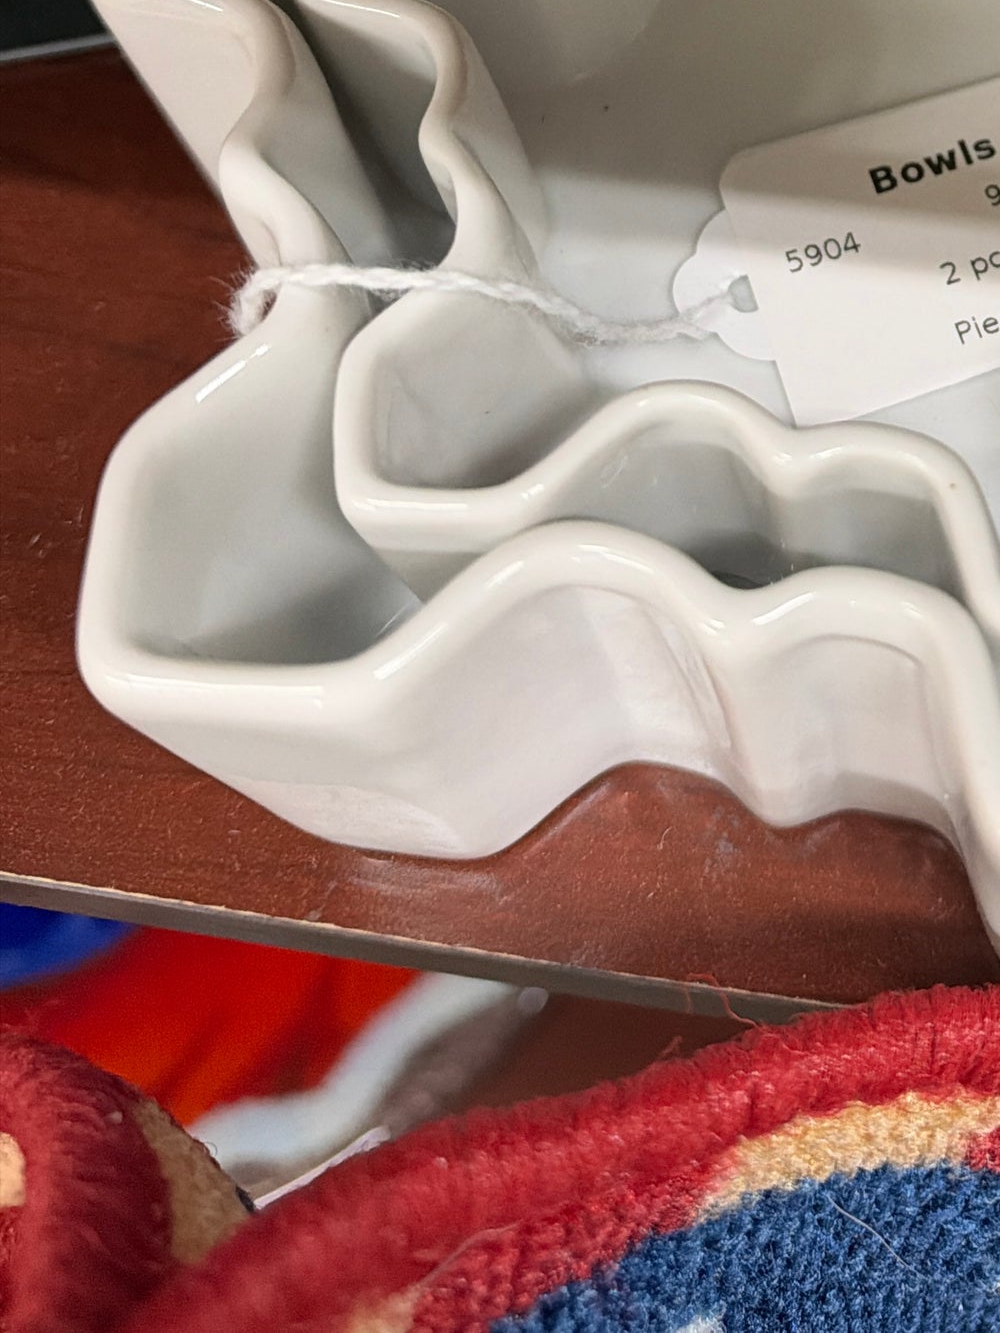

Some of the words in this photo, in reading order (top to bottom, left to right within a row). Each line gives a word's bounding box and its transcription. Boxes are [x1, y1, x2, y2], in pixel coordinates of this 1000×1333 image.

[868, 137, 997, 195] Bowls
[785, 232, 862, 274] 5904
[939, 262, 962, 286] 2
